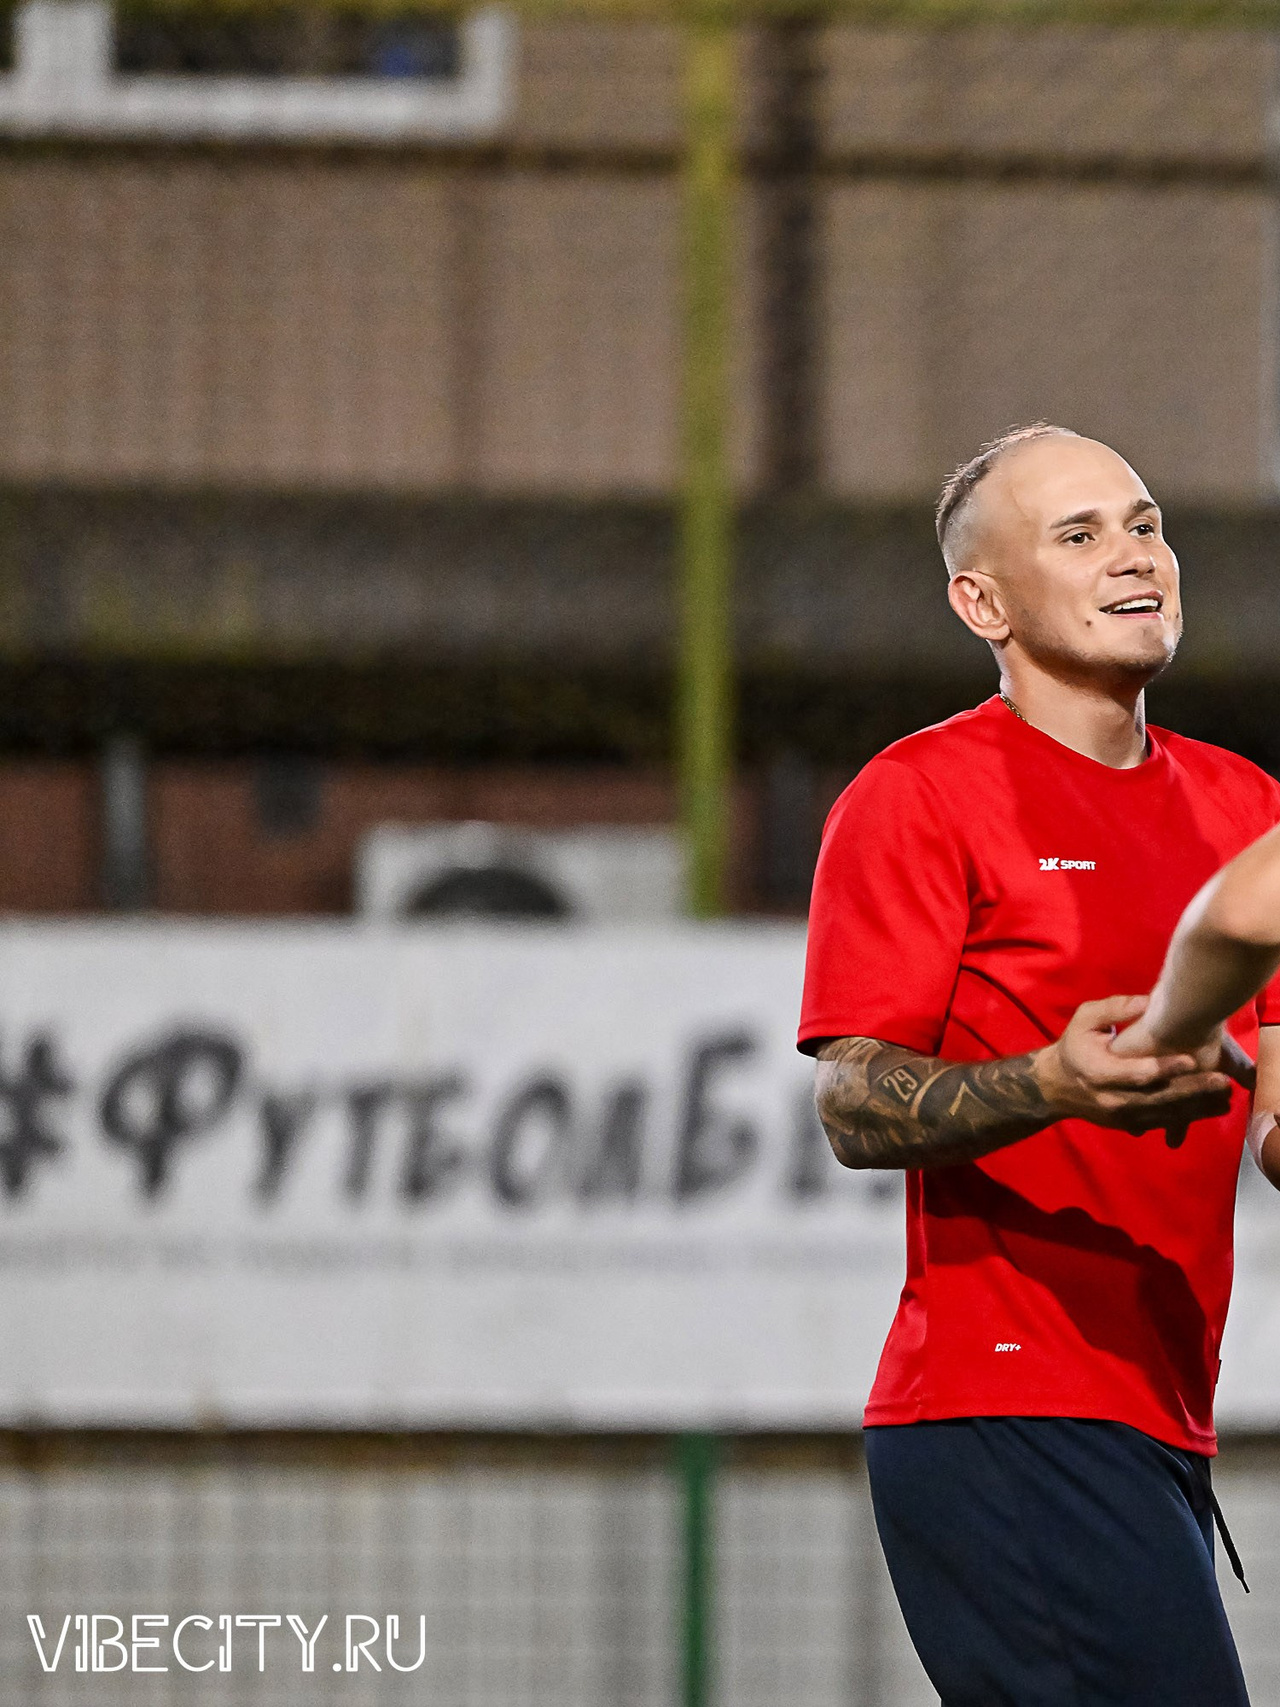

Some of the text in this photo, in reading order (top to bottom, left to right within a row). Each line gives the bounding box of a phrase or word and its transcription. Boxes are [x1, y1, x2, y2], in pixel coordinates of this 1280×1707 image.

[1039, 857, 1096, 871] 2K SPORT
[883, 1067, 919, 1104] 29
[994, 1342, 1022, 1352] DRY+
